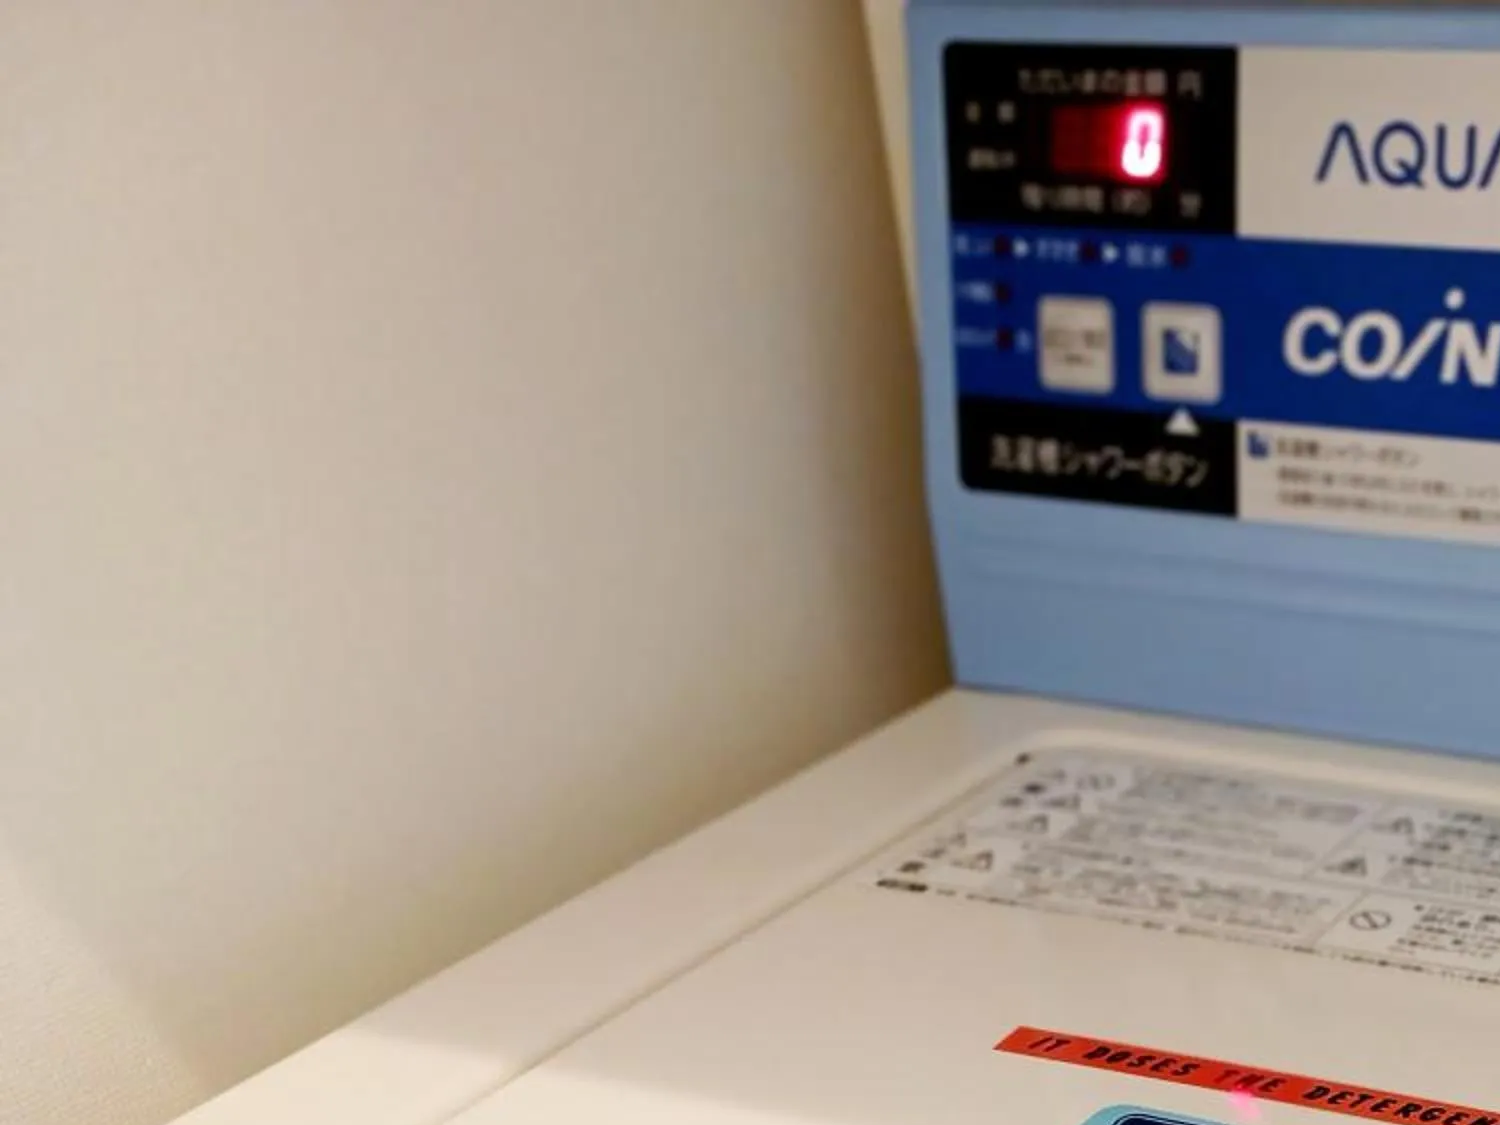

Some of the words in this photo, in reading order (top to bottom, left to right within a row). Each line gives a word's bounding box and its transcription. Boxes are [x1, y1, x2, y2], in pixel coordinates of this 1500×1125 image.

[1122, 107, 1165, 178] 0
[1027, 1035, 1071, 1051] IT
[1082, 1045, 1201, 1078] DOSES
[1215, 1068, 1286, 1094] THE
